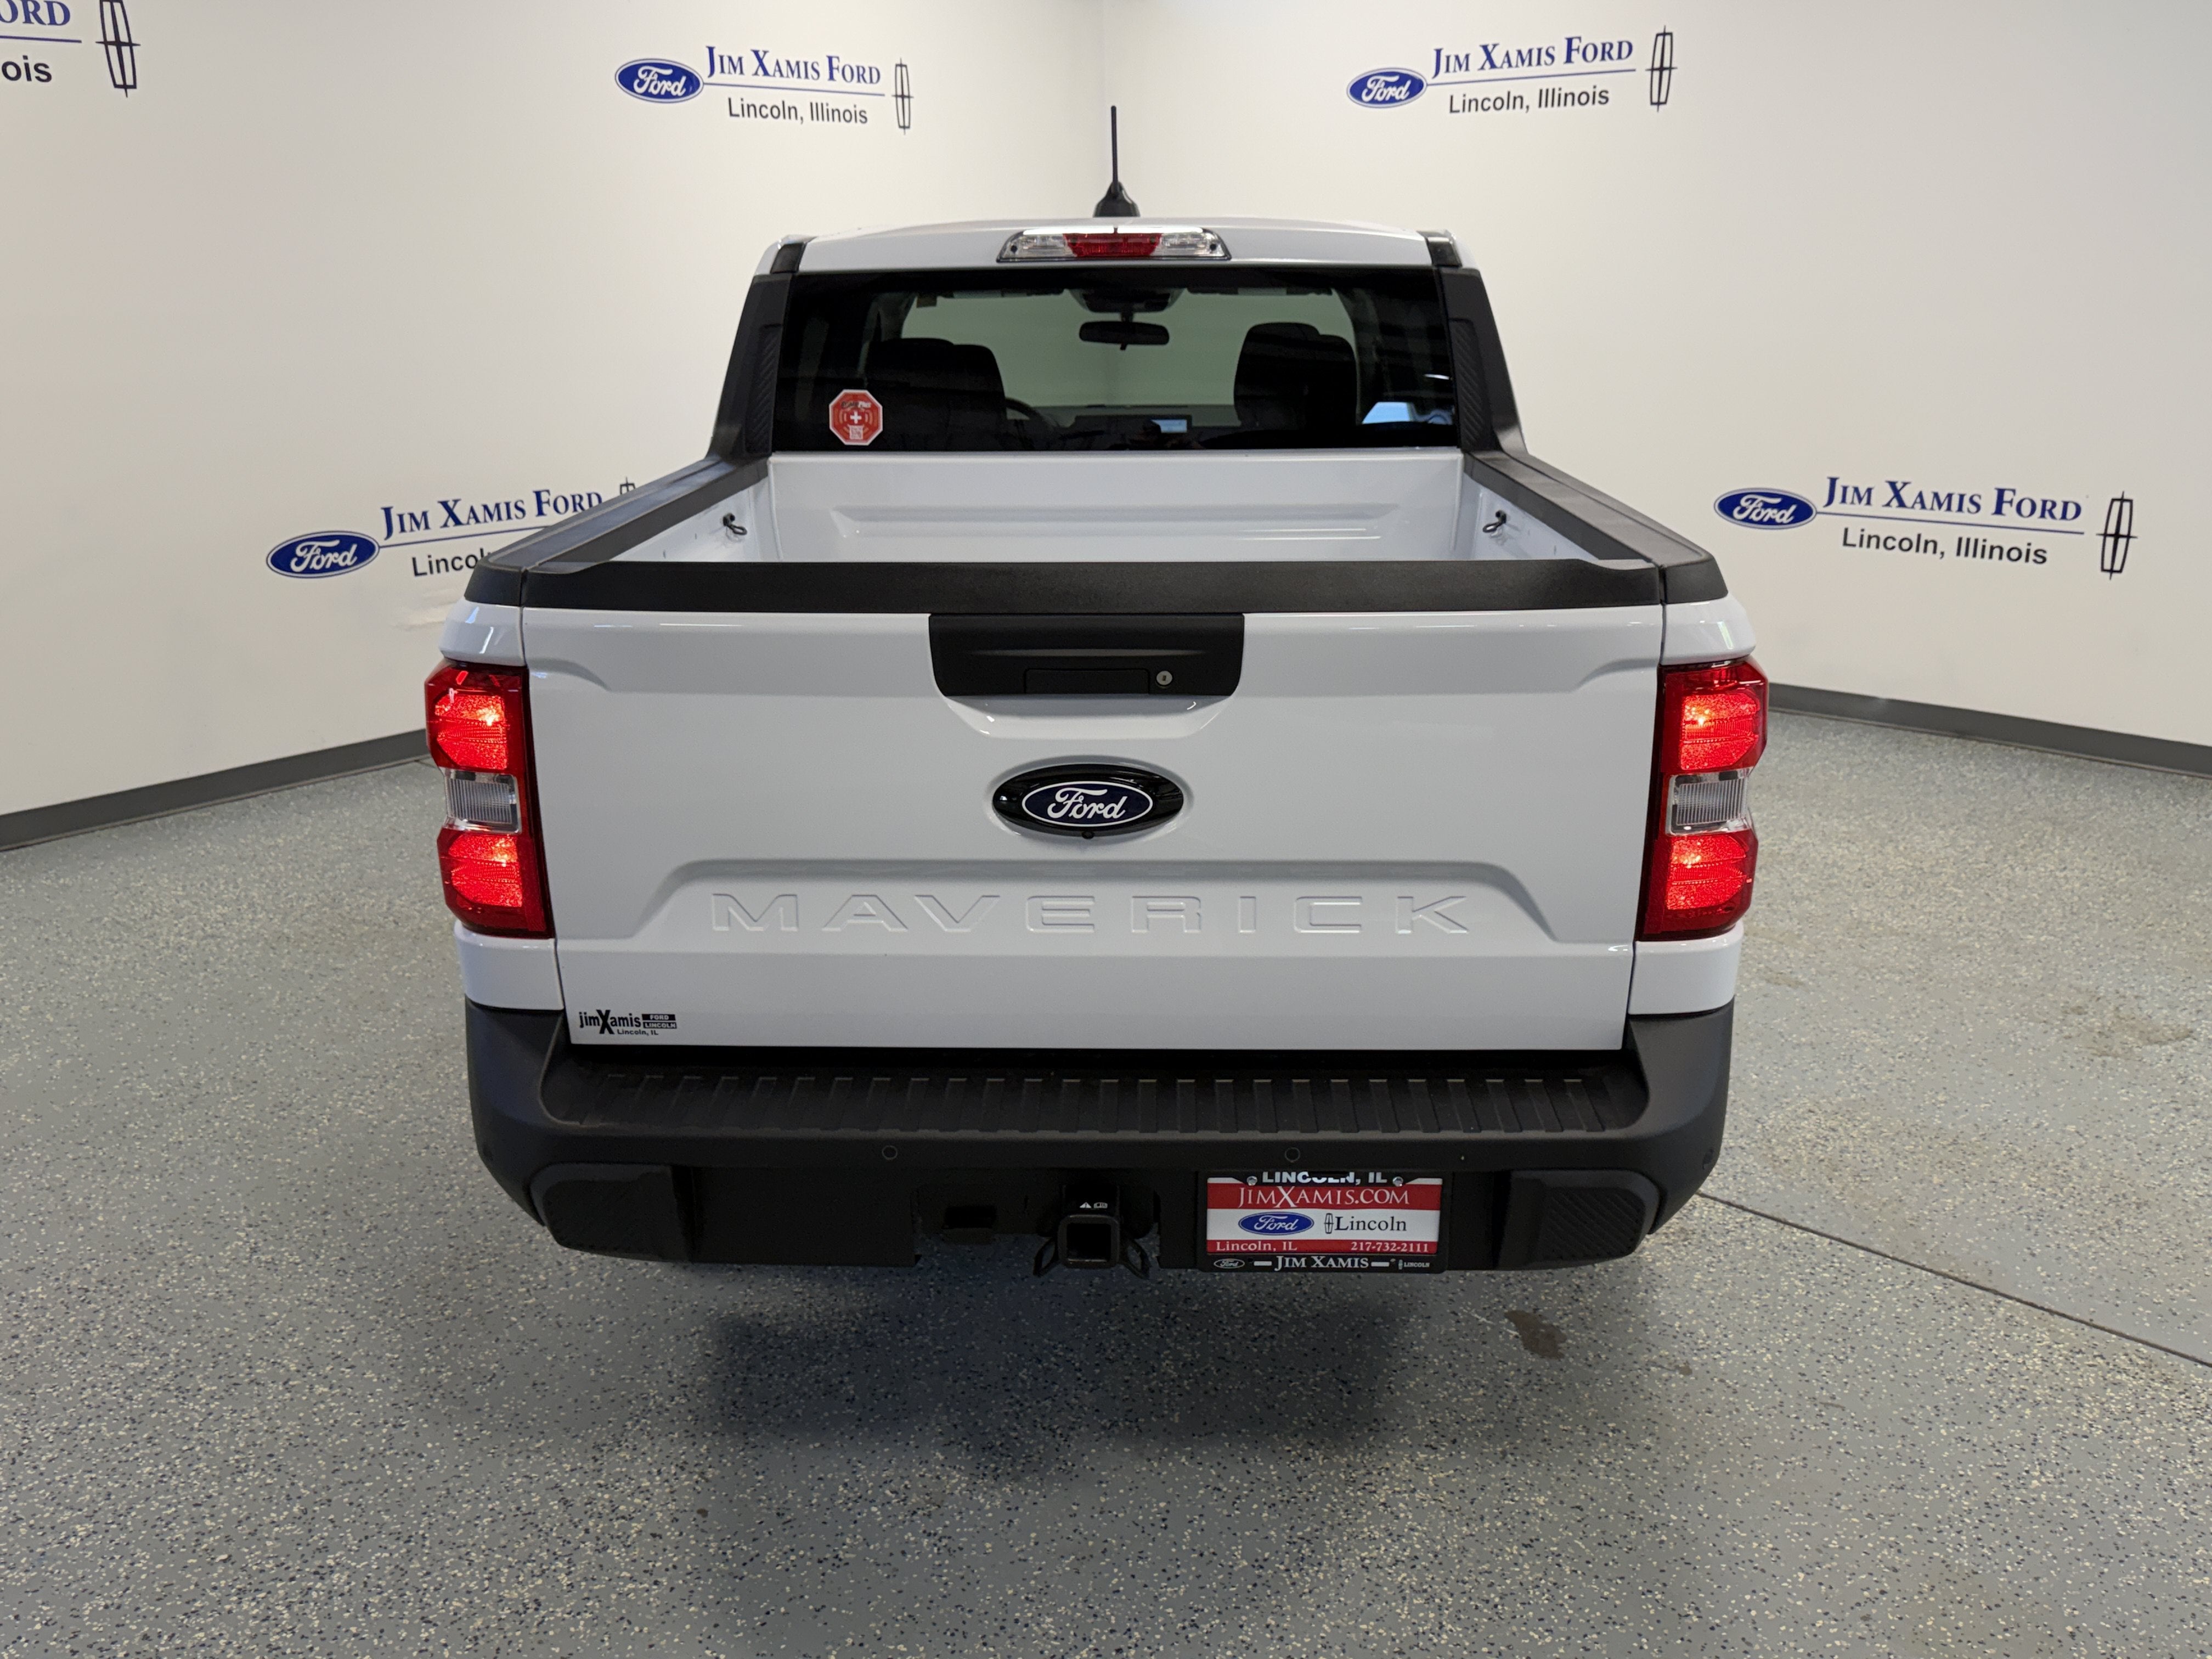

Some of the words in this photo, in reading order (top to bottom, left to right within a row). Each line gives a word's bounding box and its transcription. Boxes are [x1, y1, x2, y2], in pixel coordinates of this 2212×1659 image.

[0, 0, 71, 26] ORD
[706, 46, 745, 78] JIM
[751, 49, 821, 80] XAMIS
[826, 55, 881, 84] FORD
[1432, 48, 1470, 79] JIM
[1477, 43, 1556, 71] XAMIS
[1564, 36, 1633, 65] FORD
[634, 65, 687, 97] Ford
[1361, 75, 1410, 101] Ford
[728, 97, 804, 125] Lincoln,
[810, 102, 868, 124] Illinois
[1449, 91, 1530, 113] Lincoln,
[1538, 86, 1610, 109] Illinois
[1732, 494, 1794, 524] Ford
[1822, 476, 1873, 508] JIM
[1881, 480, 1982, 515] XAMIS
[1991, 487, 2083, 522] FORD
[381, 506, 431, 540] JIM
[438, 498, 527, 528] XAMIS
[290, 539, 358, 572] Ford
[1842, 527, 1945, 560] Lincoln,
[1955, 535, 2048, 565] Illinois
[1047, 787, 1127, 820] Ford
[712, 894, 1470, 936] MAVERICK
[1368, 1172, 1387, 1183] IL
[1254, 1214, 1299, 1232] Ford
[1335, 1216, 1407, 1232] Lincoln
[1216, 1241, 1277, 1252] Lincoln,
[1283, 1242, 1297, 1251] IL
[1351, 1241, 1429, 1253] 217-732-2111
[1220, 1260, 1239, 1268] Ford
[1274, 1256, 1307, 1272] JIM
[1311, 1256, 1369, 1268] XAMIS
